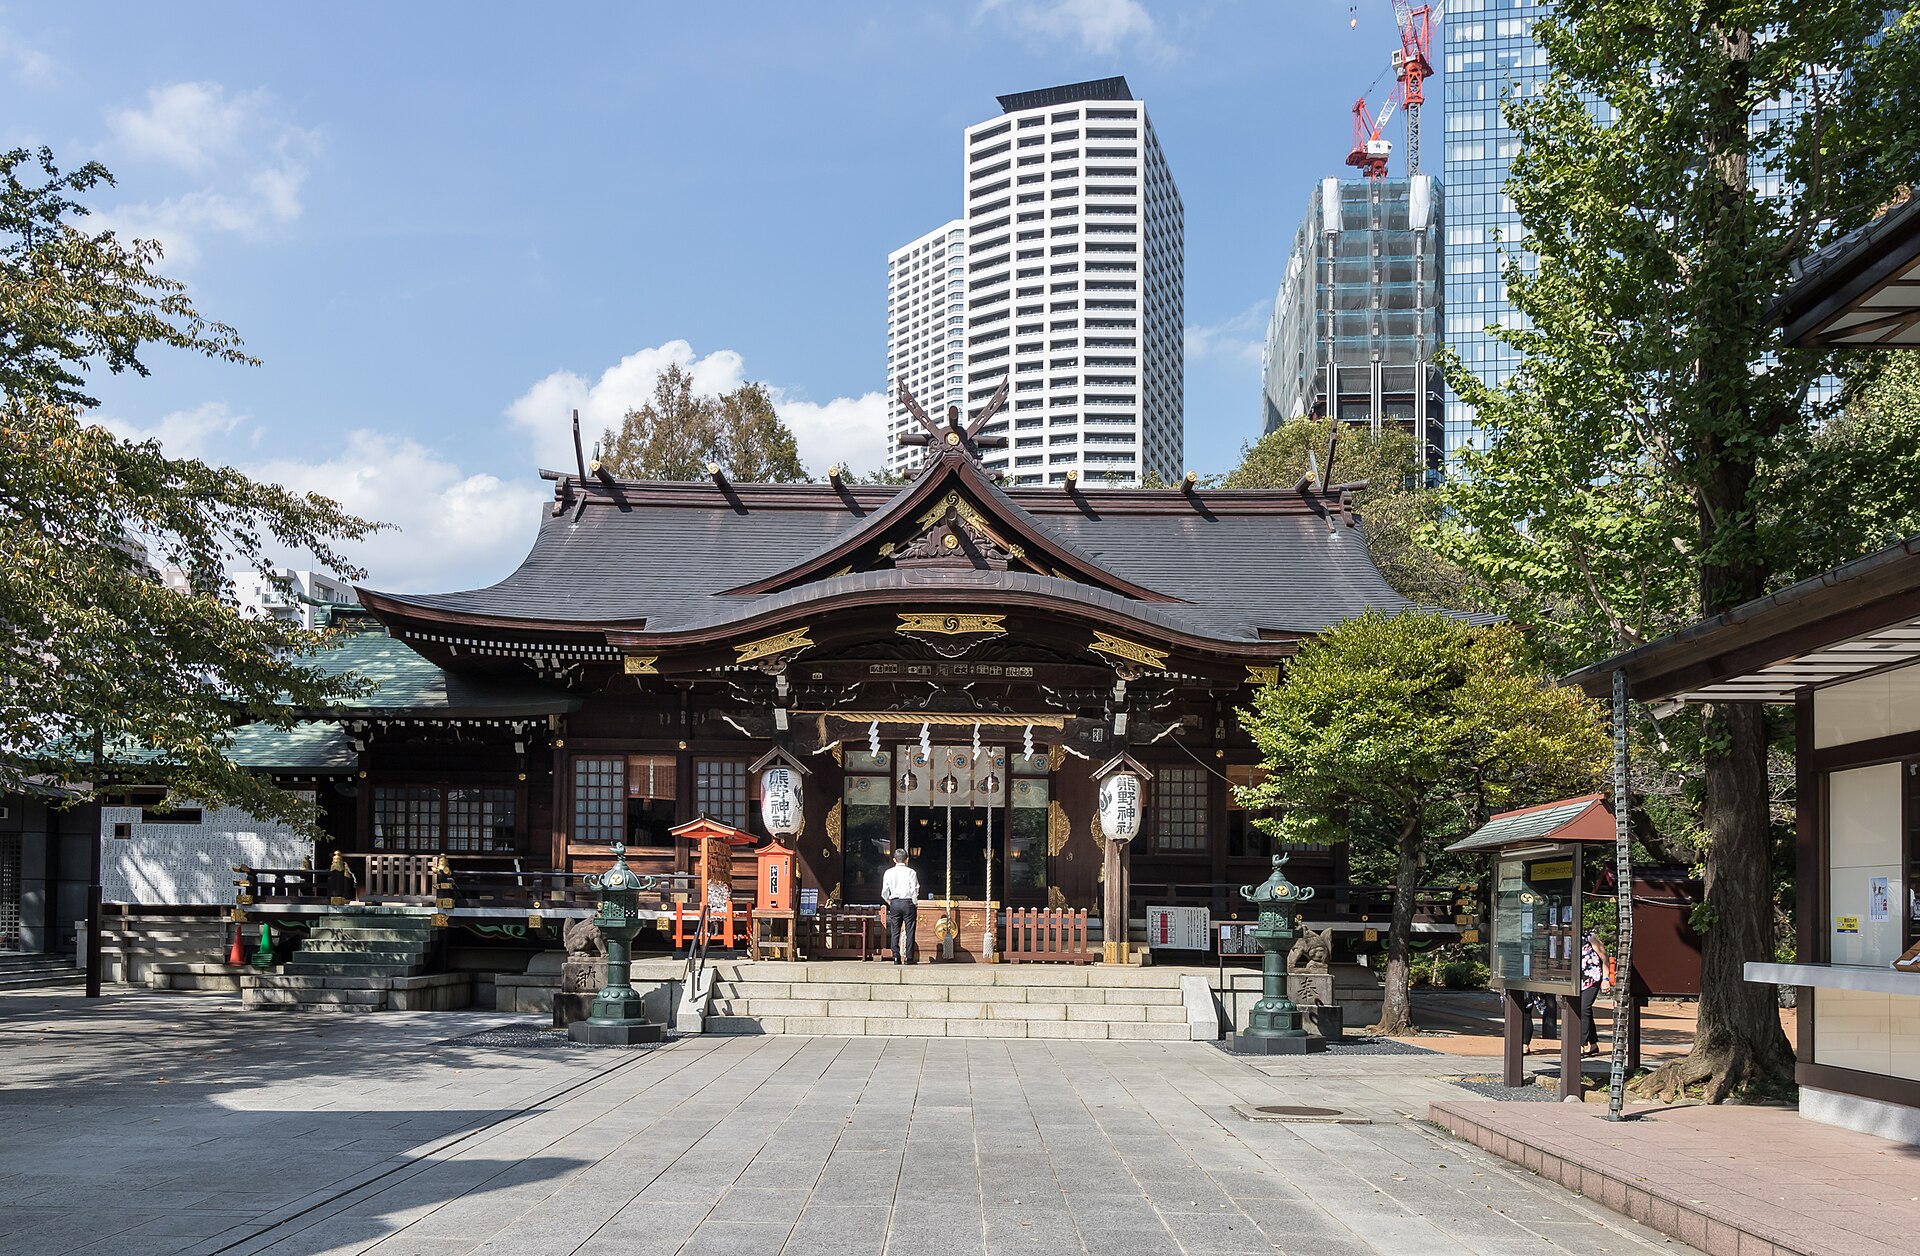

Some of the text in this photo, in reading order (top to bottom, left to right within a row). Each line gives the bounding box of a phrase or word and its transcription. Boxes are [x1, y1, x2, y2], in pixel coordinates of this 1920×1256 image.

[769, 770, 791, 829] 熊野神社
[1116, 776, 1136, 835] 熊野神社
[965, 913, 982, 929] 奉
[575, 966, 600, 989] 納
[1298, 977, 1319, 1000] 奉
